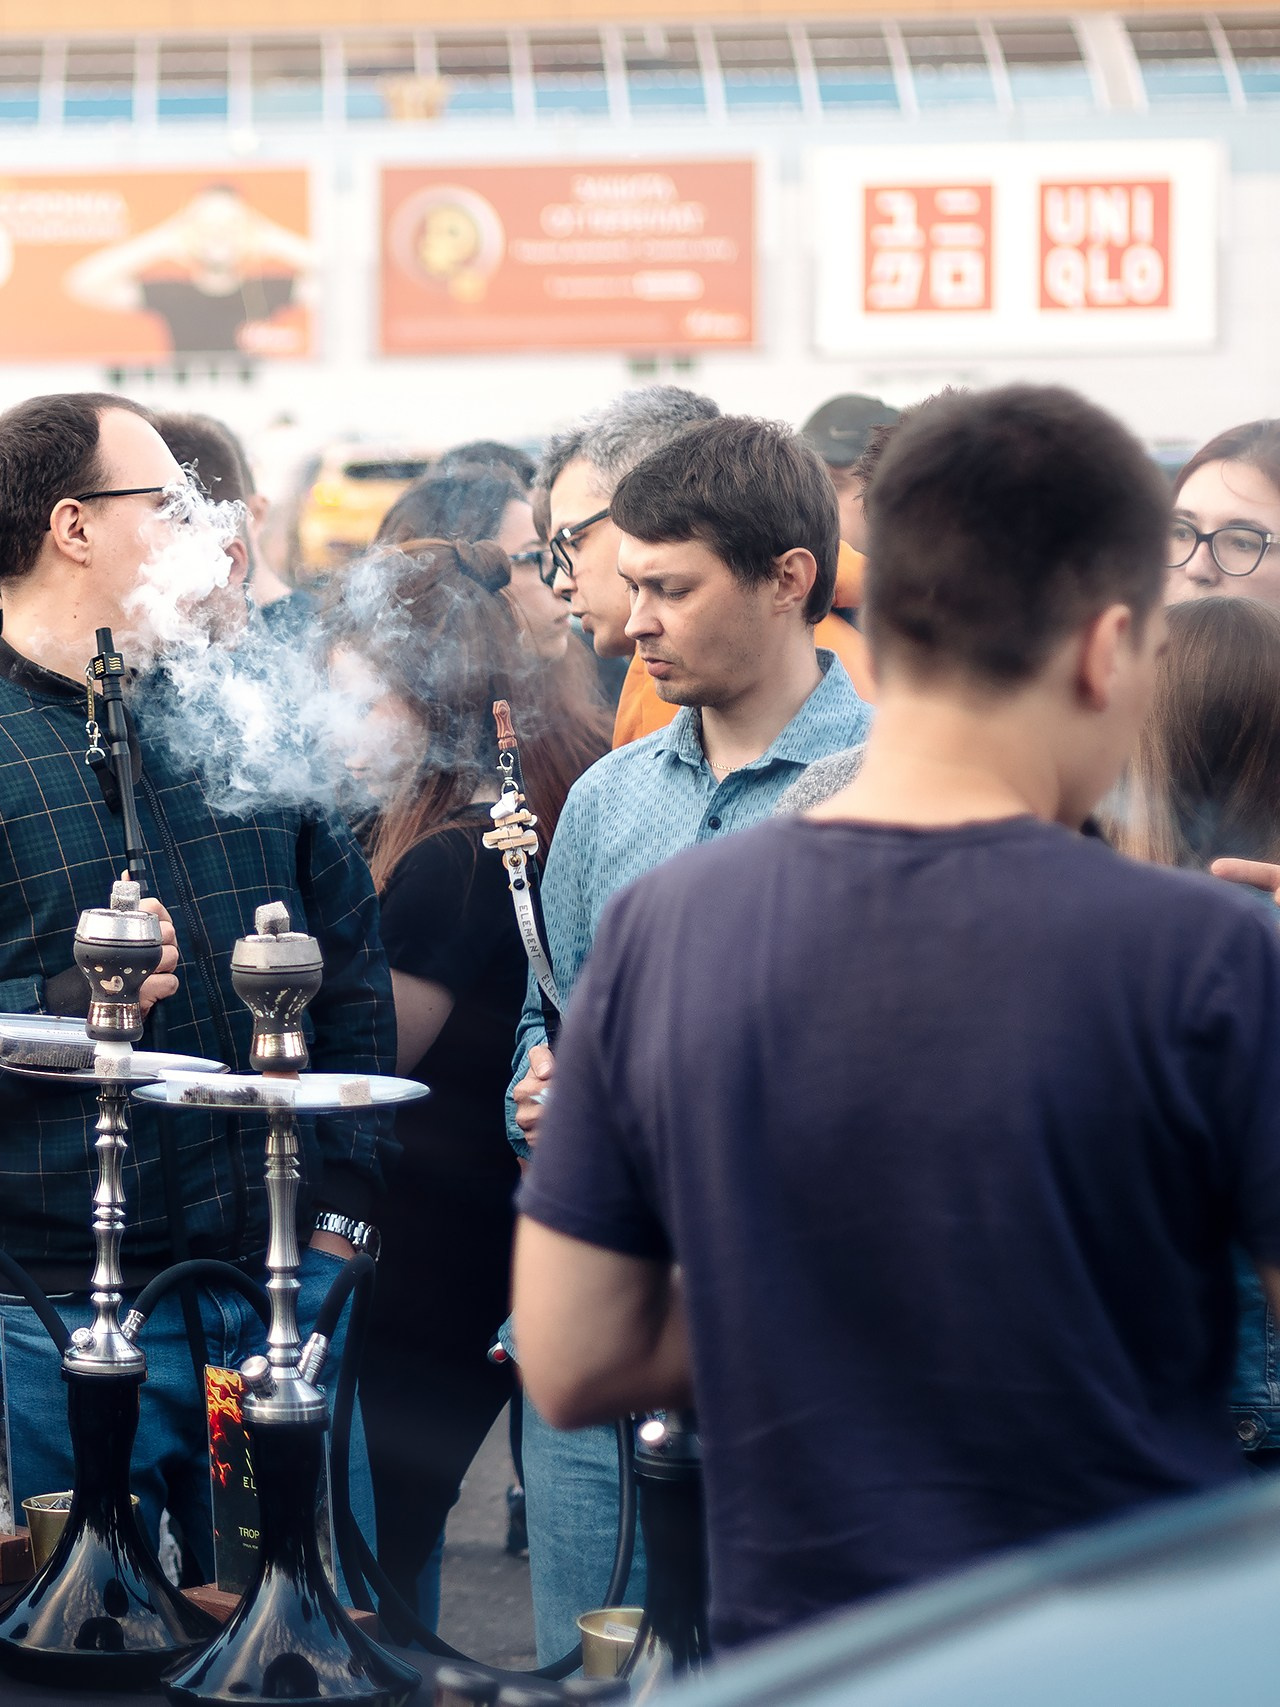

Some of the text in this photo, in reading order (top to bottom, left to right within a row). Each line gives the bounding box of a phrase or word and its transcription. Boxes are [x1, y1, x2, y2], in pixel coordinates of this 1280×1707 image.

[1045, 186, 1155, 246] UNI
[1045, 244, 1164, 306] QLO
[519, 904, 542, 960] ELEMENT
[238, 1526, 260, 1540] TROP
